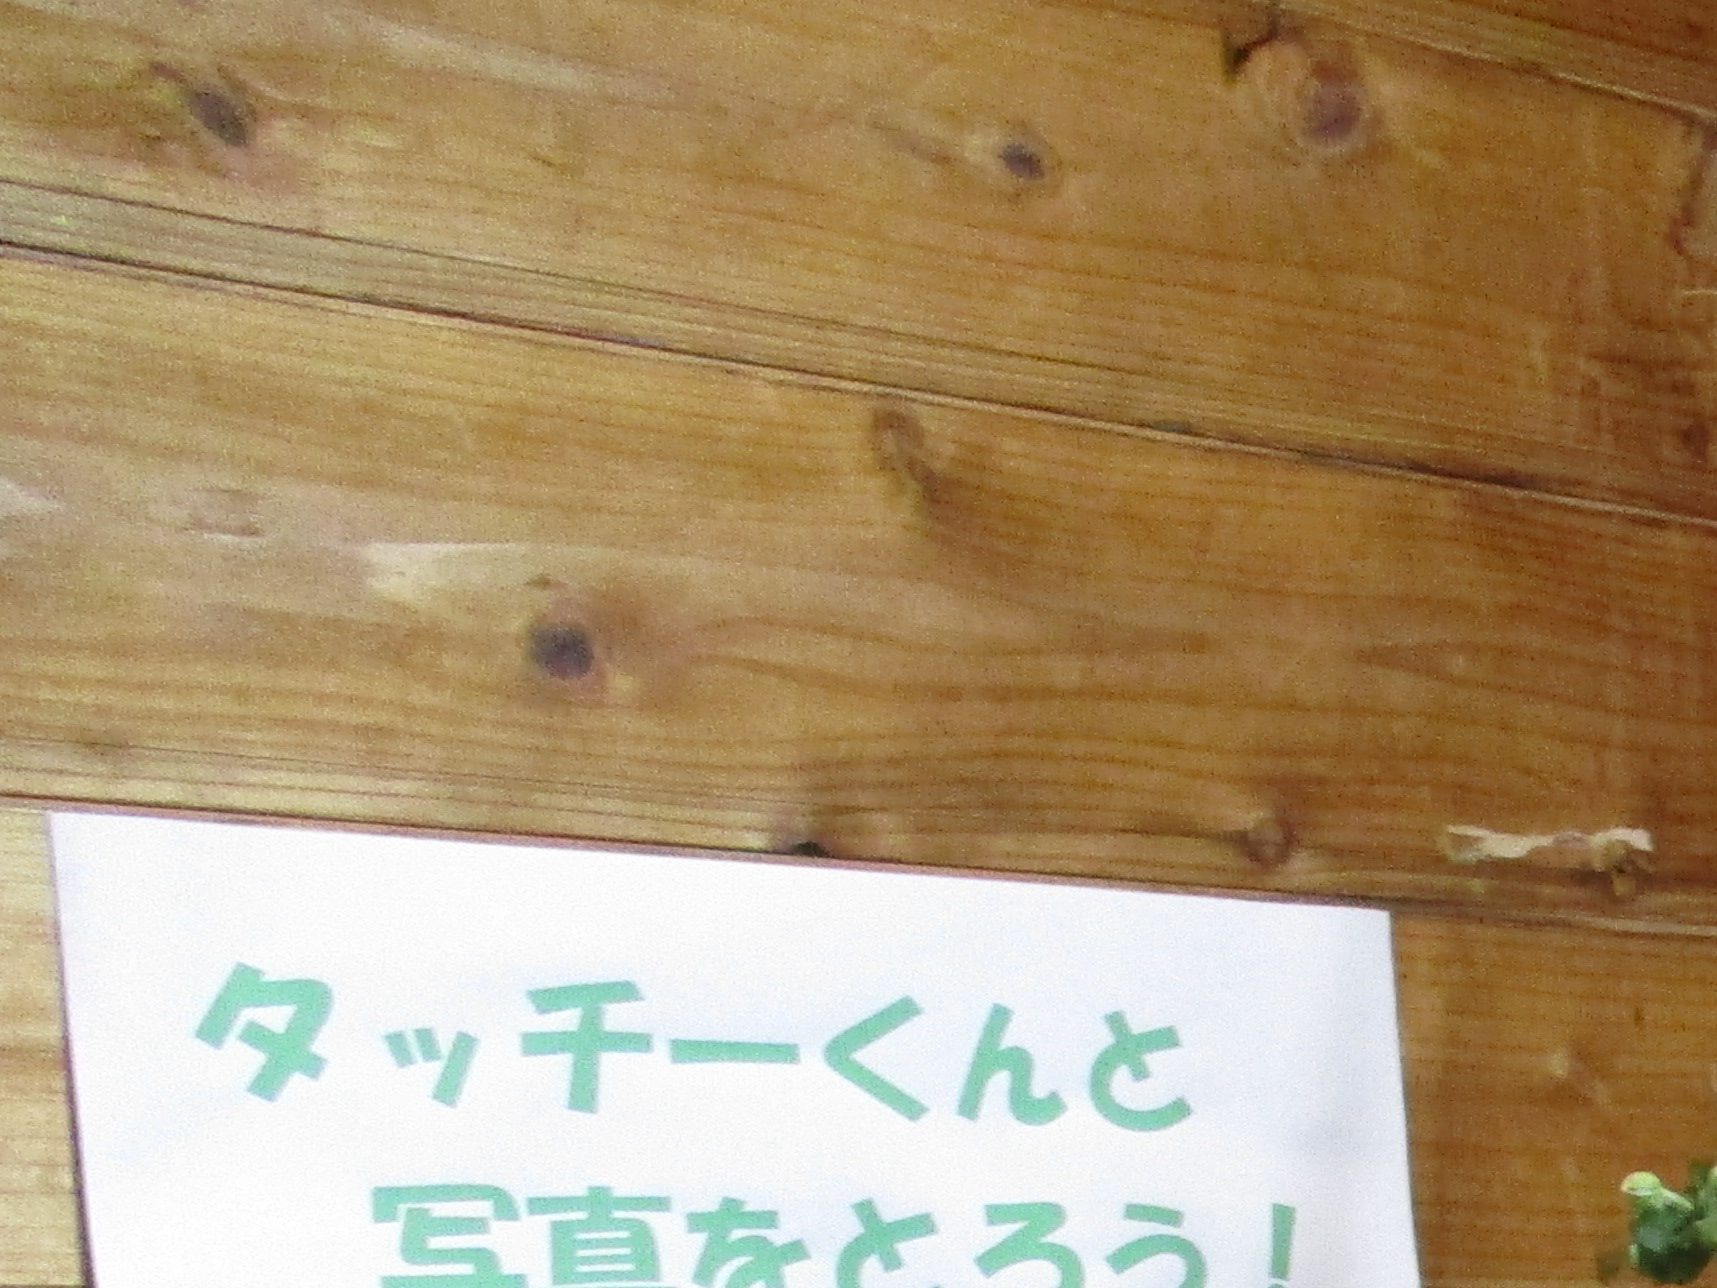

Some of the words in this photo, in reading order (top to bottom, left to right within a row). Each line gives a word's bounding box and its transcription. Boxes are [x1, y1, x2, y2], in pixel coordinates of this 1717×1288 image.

[193, 962, 1193, 1132] タッチーくんと
